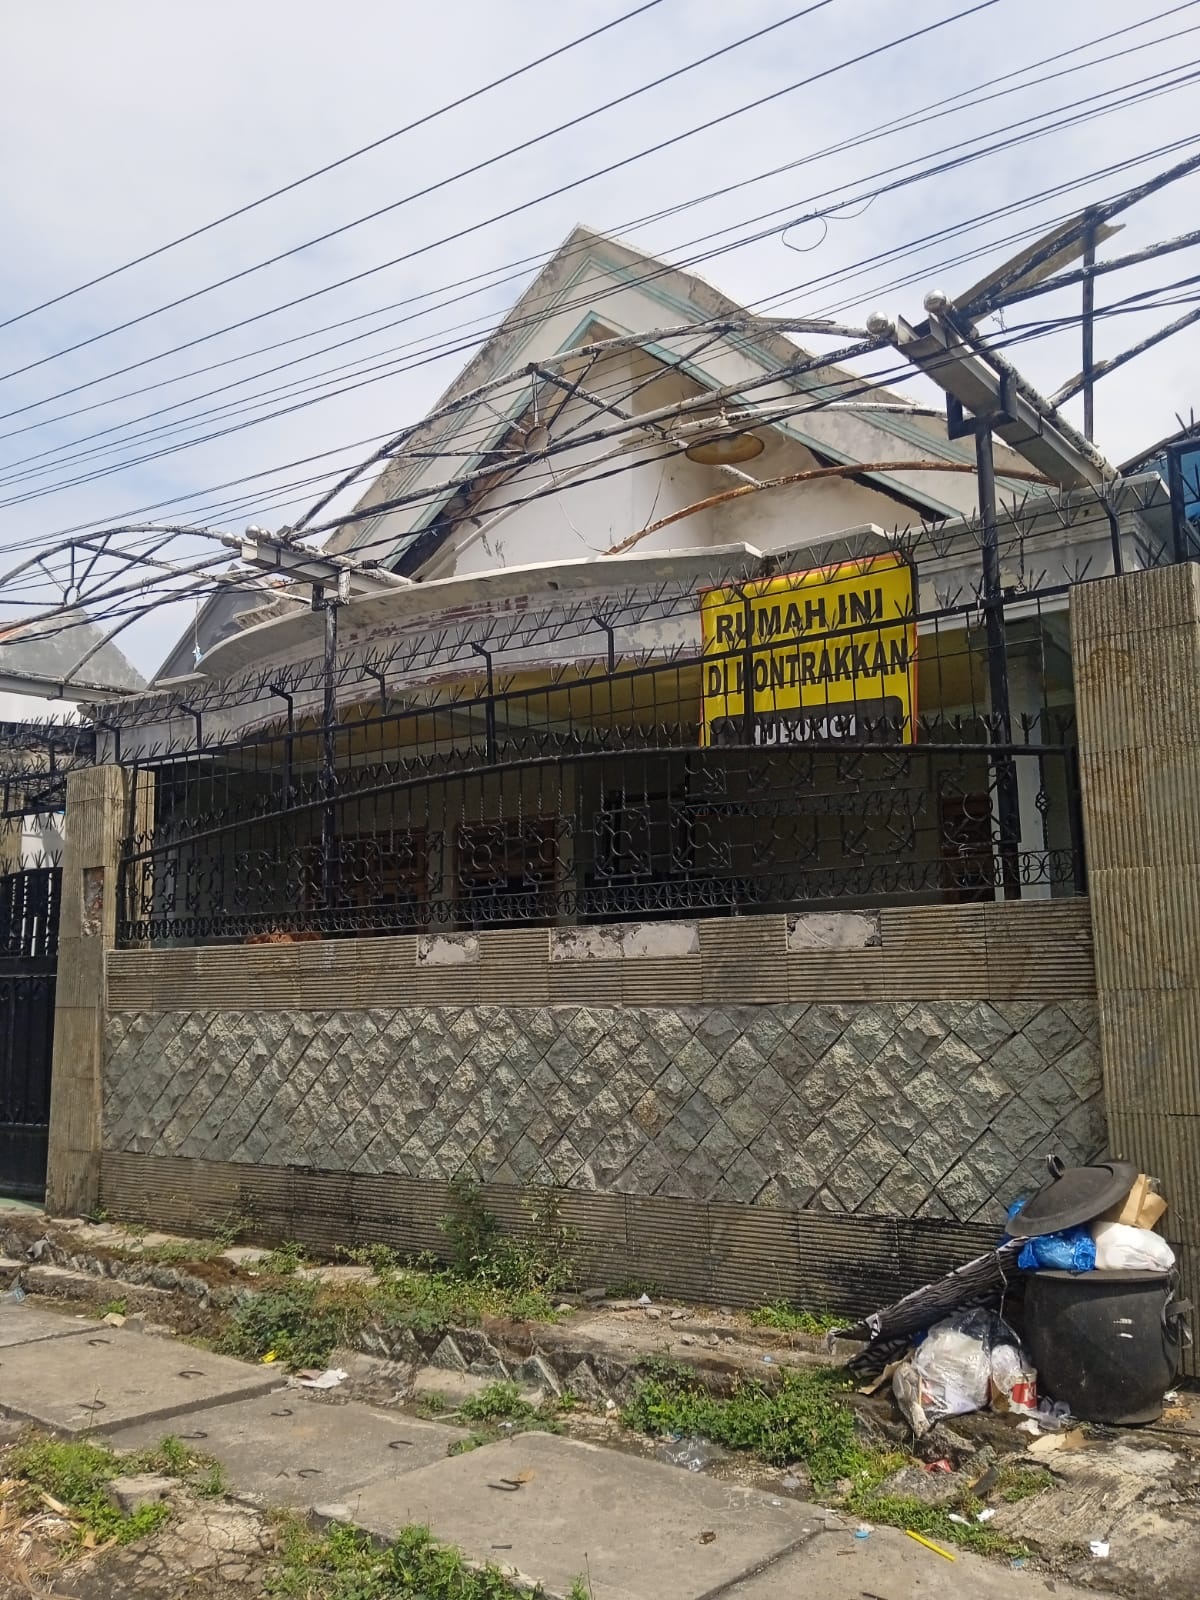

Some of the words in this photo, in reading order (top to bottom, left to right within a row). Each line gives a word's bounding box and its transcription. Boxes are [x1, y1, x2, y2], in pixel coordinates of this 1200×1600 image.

[716, 598, 827, 644] RUMAH
[838, 588, 883, 624] INI
[708, 664, 728, 698] DI
